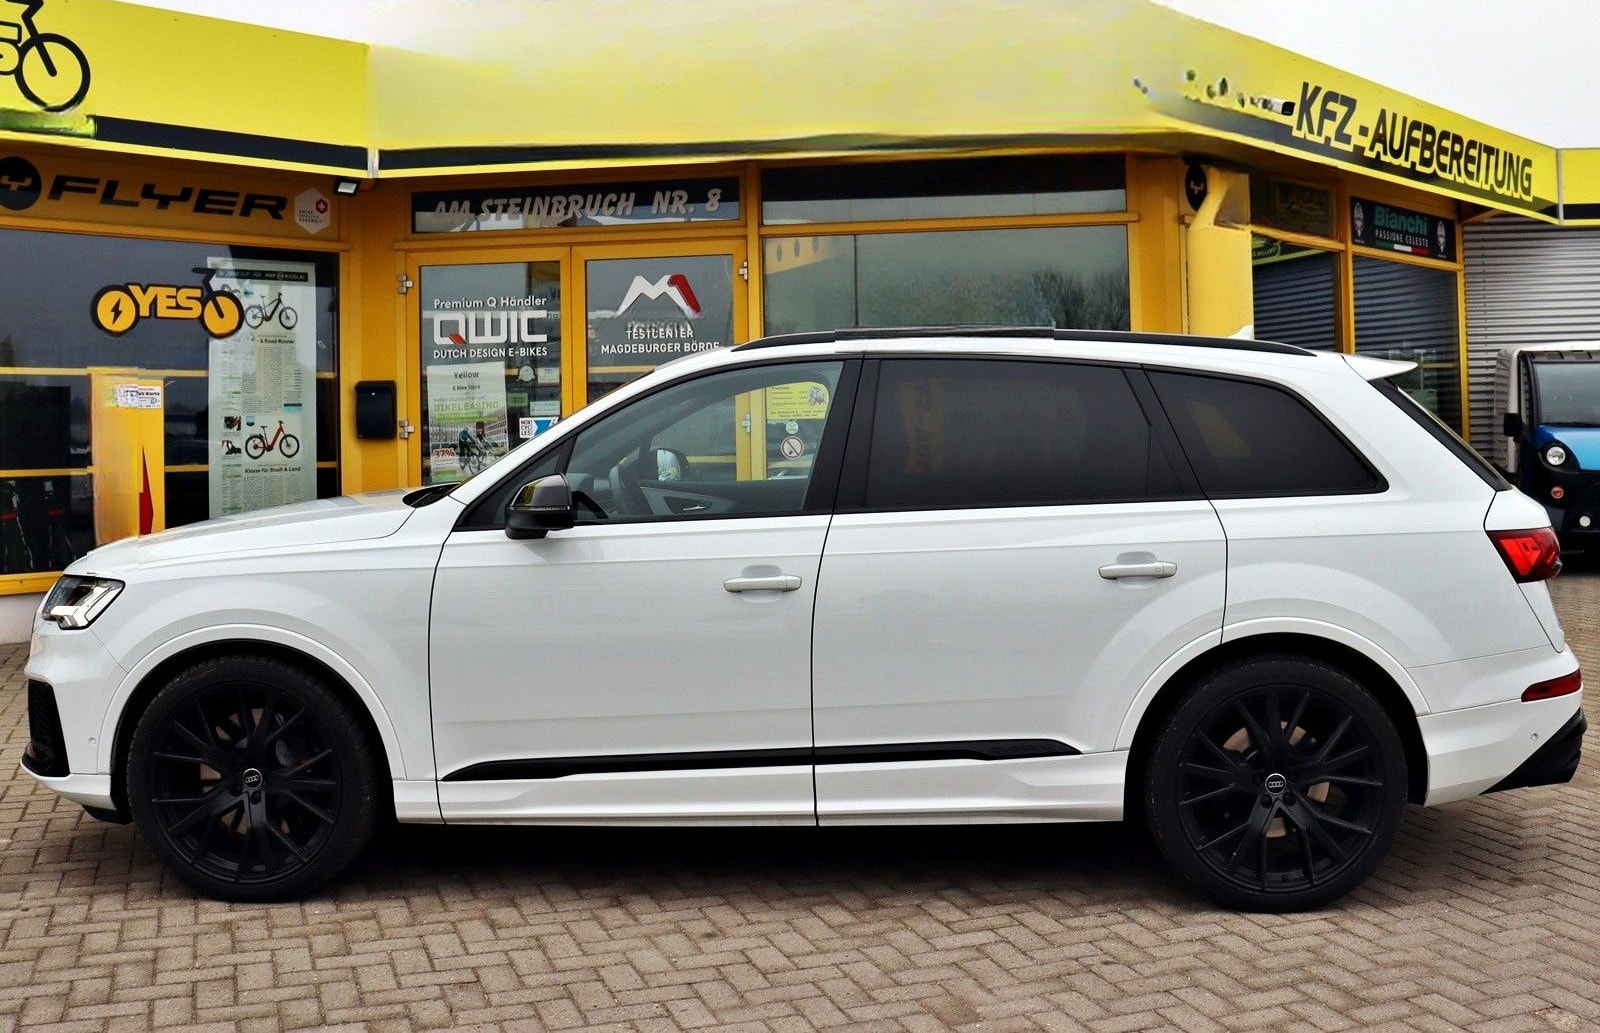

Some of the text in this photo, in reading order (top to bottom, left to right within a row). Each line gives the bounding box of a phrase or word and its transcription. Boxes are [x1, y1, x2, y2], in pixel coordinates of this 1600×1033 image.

[47, 175, 288, 220] FLYER
[434, 187, 723, 223] AM STEINBRUCH NR. 8
[1374, 205, 1429, 236] Bianchi
[1375, 228, 1429, 248] PASSIONE CELESTE
[128, 284, 203, 320] YES
[433, 295, 548, 309] Premium Q Händler
[433, 309, 548, 346] QWIC
[433, 346, 548, 359] DUTCH DESIGN E-BIKES
[601, 342, 681, 354] MAGDEBURGER
[453, 370, 480, 379] Yellow
[433, 448, 456, 459] 37%
